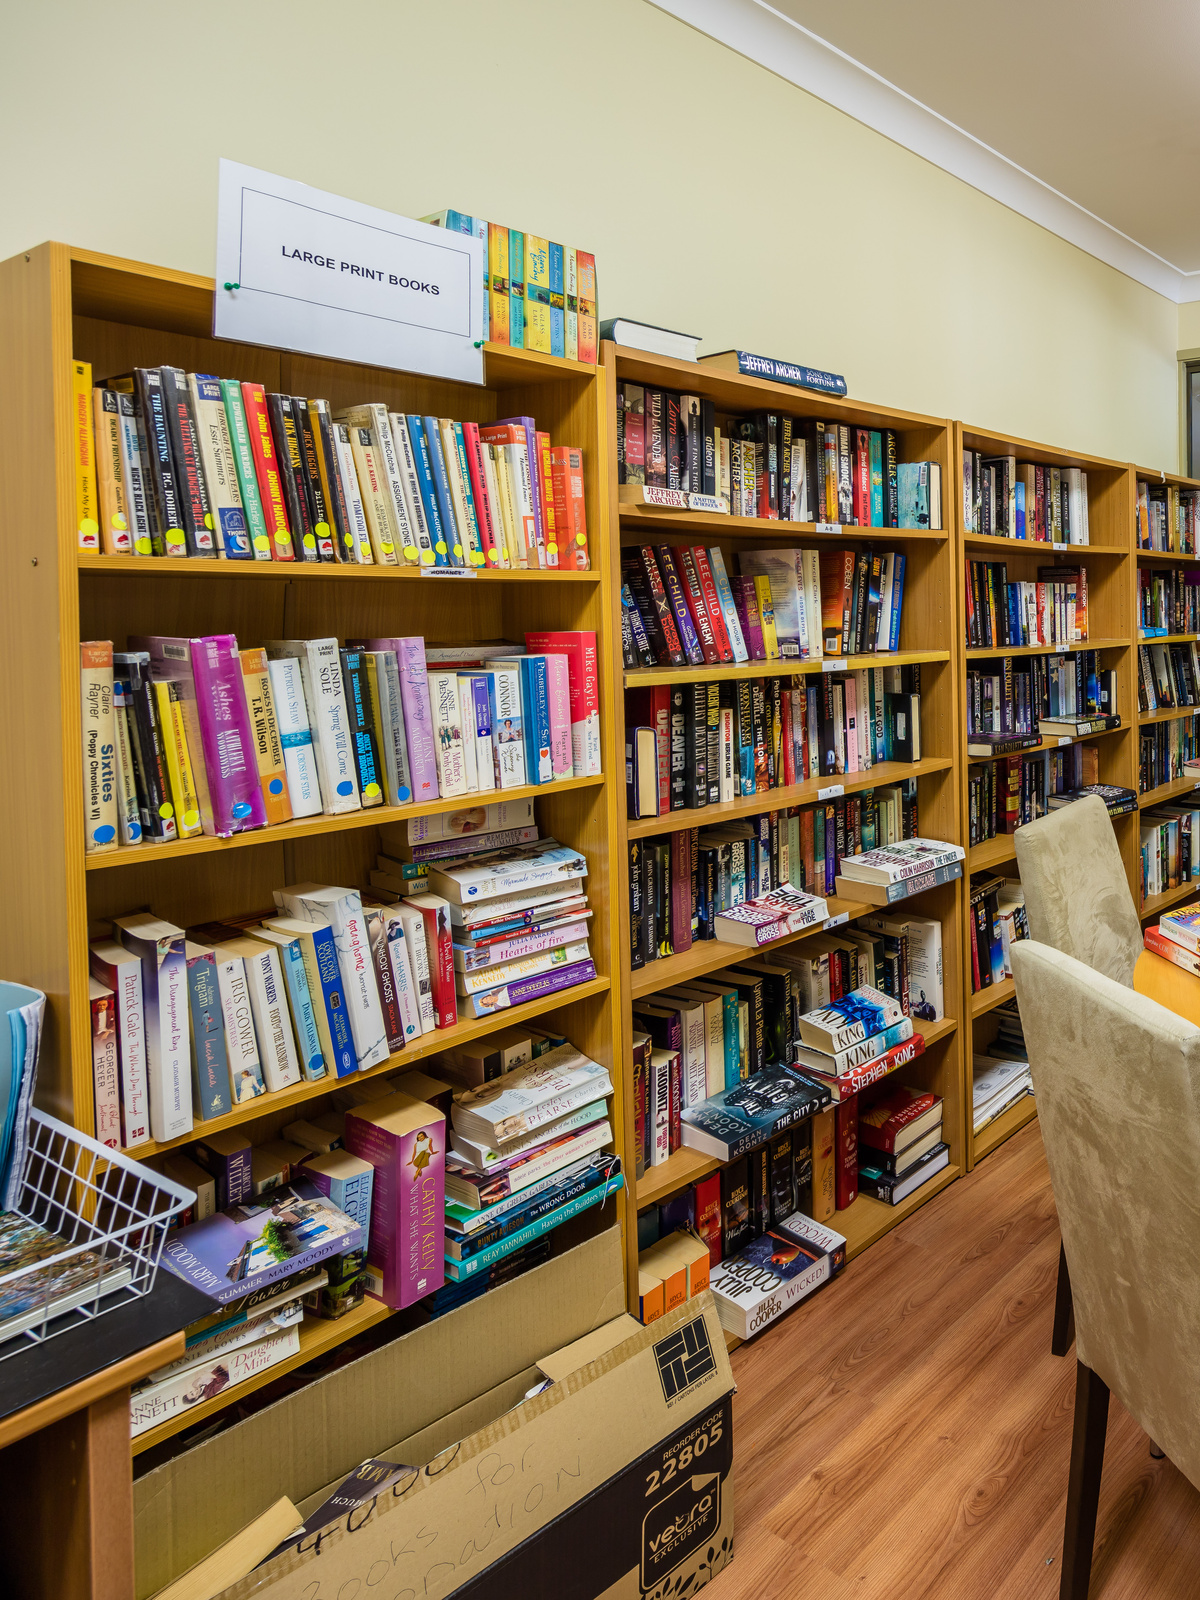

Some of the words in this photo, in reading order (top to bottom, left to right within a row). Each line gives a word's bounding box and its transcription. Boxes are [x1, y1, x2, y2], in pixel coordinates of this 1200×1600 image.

[282, 245, 335, 269] LARGE
[340, 262, 384, 281] PRINT
[388, 274, 440, 295] BOOKS
[78, 393, 88, 427] MARGERY
[152, 394, 163, 413] THE
[651, 393, 661, 416] WILD
[669, 400, 680, 435] Zorro
[153, 415, 169, 462] HAUNTING
[256, 412, 269, 432] John
[379, 422, 388, 439] Philip
[79, 428, 89, 466] ALLINGHAM
[260, 435, 273, 458] Jakes
[382, 440, 396, 474] McCutchan
[651, 418, 662, 464] LAVENDER
[705, 437, 715, 466] gideon
[840, 427, 849, 455] HUMAN
[888, 434, 896, 477] ARCHER
[732, 442, 740, 480] ARCHER
[744, 445, 755, 490] ARCHER
[841, 456, 850, 485] SMOKE
[661, 546, 673, 573] LEE
[668, 576, 686, 617] CHILD
[699, 558, 710, 579] LEE
[705, 581, 720, 616] CHILD
[695, 600, 705, 617] THE
[700, 618, 714, 645] ENEMY
[585, 647, 594, 672] Mike
[319, 667, 332, 695] SOLE
[329, 661, 341, 697] LINDA
[352, 673, 362, 701] THOMAS
[586, 676, 595, 707] Gayle
[88, 683, 100, 719] Rayner
[101, 685, 111, 715] Claire
[251, 696, 263, 717] T.R.
[447, 689, 455, 712] ANNE
[499, 675, 511, 717] CONNOR
[328, 705, 344, 731] Spring
[355, 703, 365, 726] BOYLE
[87, 730, 99, 758] (Poppy
[255, 718, 268, 754] Wilson
[335, 732, 347, 749] Will
[410, 727, 425, 777] MORIARTY
[422, 736, 433, 764] LIANE
[672, 717, 685, 772] DEAVER
[101, 744, 114, 803] Sixties
[336, 750, 348, 775] Come
[443, 751, 452, 765] Only
[452, 751, 463, 782] Mother's
[90, 761, 100, 802] Chronicles
[445, 767, 454, 787] Child
[90, 805, 101, 820] VI)
[375, 938, 391, 971] UNHOLY
[124, 974, 138, 1009] Patrick
[195, 967, 211, 1008] Trigiani
[231, 977, 249, 1005] IRIS
[379, 972, 394, 1003] GHOSTS
[394, 961, 408, 992] HARRIS
[127, 1012, 139, 1038] Gale
[235, 1008, 255, 1059] GOWER
[837, 1023, 865, 1048] KING
[106, 1042, 116, 1096] GEORGETTE
[845, 1041, 875, 1069] KING
[851, 1060, 888, 1092] STEPHEN
[894, 1044, 915, 1068] KING
[97, 1056, 107, 1088] HEYER
[528, 1100, 574, 1125] PEARSE
[409, 1183, 418, 1217] WHAT
[420, 1177, 436, 1226] CATHY
[409, 1220, 418, 1240] SHE
[483, 1250, 501, 1264] REAY
[499, 1228, 537, 1254] TANNAHILL
[409, 1242, 418, 1280] WANTS
[420, 1231, 436, 1270] KELLY
[218, 1277, 263, 1302] SUMMER
[268, 1264, 298, 1280] MARY
[300, 1243, 335, 1268] MOODY
[786, 1265, 825, 1299] WICKED!
[750, 1301, 782, 1331] COOPER
[663, 1428, 700, 1461] REORDER
[702, 1409, 723, 1432] CODE
[645, 1420, 723, 1497] 22805
[654, 1513, 708, 1564] EXCLUSIVE
